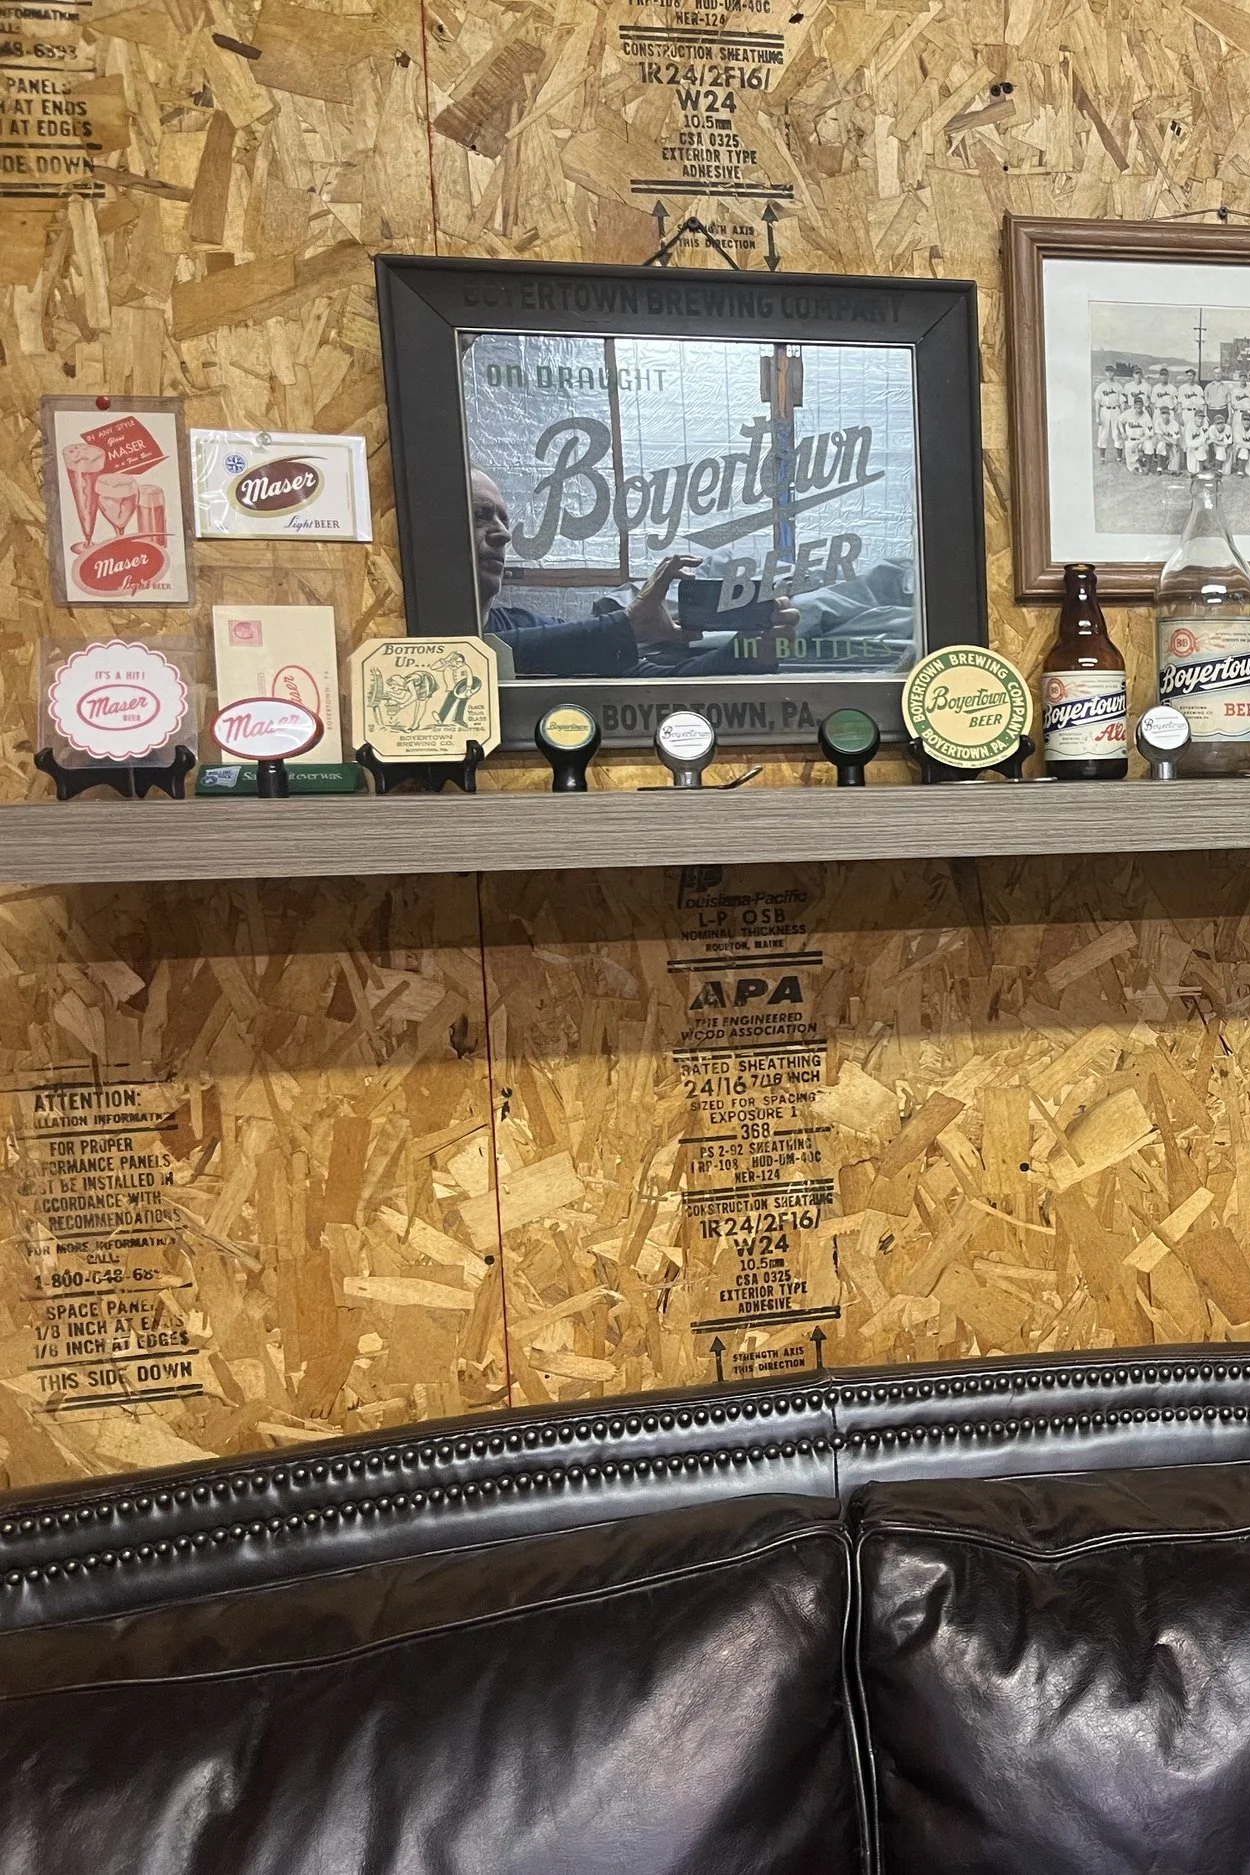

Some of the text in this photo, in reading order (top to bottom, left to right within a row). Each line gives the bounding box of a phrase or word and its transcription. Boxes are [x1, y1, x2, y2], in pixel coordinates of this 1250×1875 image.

[623, 42, 783, 65] CONSTRUCTION SHEATHING
[7, 77, 72, 95] PANELS
[14, 100, 87, 117] AT ENDS
[676, 89, 737, 113] W24
[10, 120, 93, 137] AT EDGES
[679, 132, 740, 147] CSA 0325
[37, 155, 95, 174] DOWN
[662, 147, 757, 164] EXTERIOR TYPE
[682, 164, 741, 179] ADHESIVE
[733, 225, 754, 236] AXIS
[537, 365, 668, 392] DRAUGHT
[107, 439, 146, 461] MASER
[241, 472, 316, 502] Maser
[512, 416, 885, 561] Boyertown
[284, 515, 341, 533] Light BEER
[94, 552, 150, 579] Maser
[717, 532, 863, 623] BEER
[95, 671, 110, 681] IT'S
[115, 671, 121, 681] A
[910, 653, 1026, 740] BOYERTOWN BREWING COMPANY
[926, 685, 1010, 715] Boyertown
[87, 697, 148, 719] Maser
[123, 714, 141, 722] BEER
[968, 713, 1003, 728] BEER
[699, 907, 786, 928] L-P OSB
[681, 924, 807, 941] NOMINAL THICKNESS
[754, 939, 785, 949] MAINE
[689, 975, 804, 1011] APA
[695, 1011, 803, 1028] THE ENGINEERED
[681, 1022, 818, 1041] WOOD ASSOCIATION
[682, 1055, 822, 1077] RATED SHEATHING
[684, 1070, 821, 1100] 24/16 INCH
[34, 1090, 142, 1113] ATTENTION:
[690, 1091, 817, 1111] SIZED FOR SPACING
[710, 1105, 798, 1125] EXPOSURE 1
[740, 1122, 771, 1141] 368
[50, 1137, 133, 1157] FOR PROPER
[700, 1137, 812, 1159] PS 2-92 SHEATHING
[120, 1153, 171, 1170] PANELS
[60, 1171, 174, 1193] BE INSTALLED IN
[734, 1168, 781, 1184] NER-124
[128, 1190, 162, 1206] WITH
[687, 1191, 834, 1217] CONSTRUCTION SHEATHING
[48, 1206, 182, 1232] RECOMMENDATIONS
[27, 1242, 51, 1257] FOR
[57, 1240, 89, 1254] MORE
[733, 1233, 790, 1258] W24
[740, 1257, 785, 1272] 10.5mm
[736, 1269, 792, 1287] CSA 0325
[719, 1280, 808, 1302] EXTERIOR TYPE
[47, 1302, 99, 1321] SPACE
[738, 1296, 792, 1314] ADHESIVE
[35, 1318, 134, 1341] 1/8 INCH AT
[66, 1339, 107, 1356] INCH
[112, 1338, 130, 1352] AT
[137, 1330, 190, 1350] EDGES
[732, 1346, 805, 1363] STRENGTH AXIS
[38, 1361, 193, 1392] THIS SIDE DOWN
[733, 1358, 805, 1375] THIS DIRECTION
